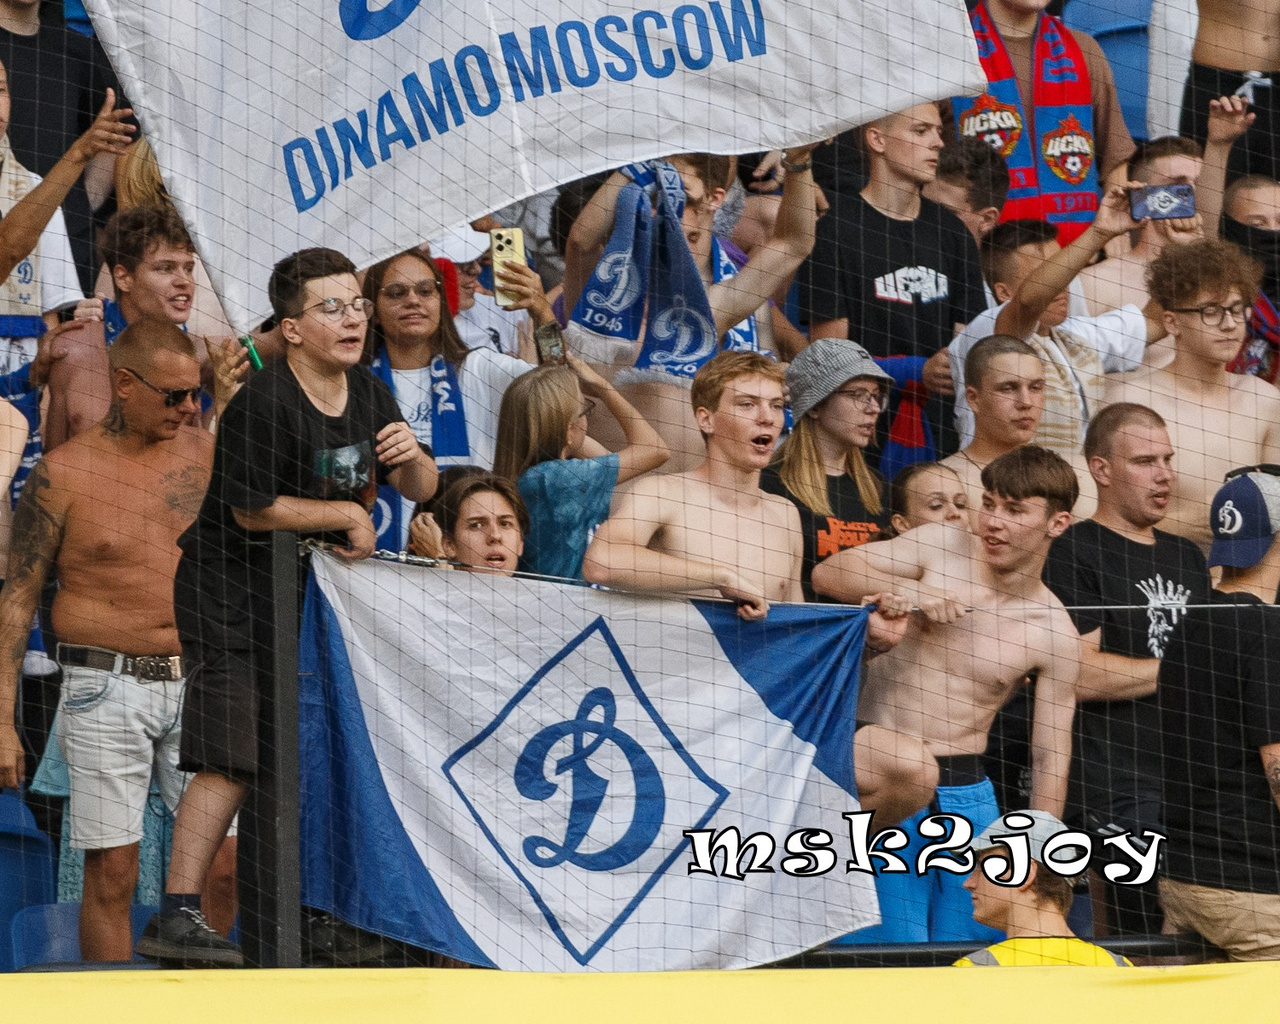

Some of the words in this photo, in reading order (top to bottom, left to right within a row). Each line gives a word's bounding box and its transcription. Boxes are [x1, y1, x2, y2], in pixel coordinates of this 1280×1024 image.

[283, 43, 502, 213] DINAMO
[962, 112, 1020, 137] ЦСКА
[1052, 195, 1092, 212] 1911
